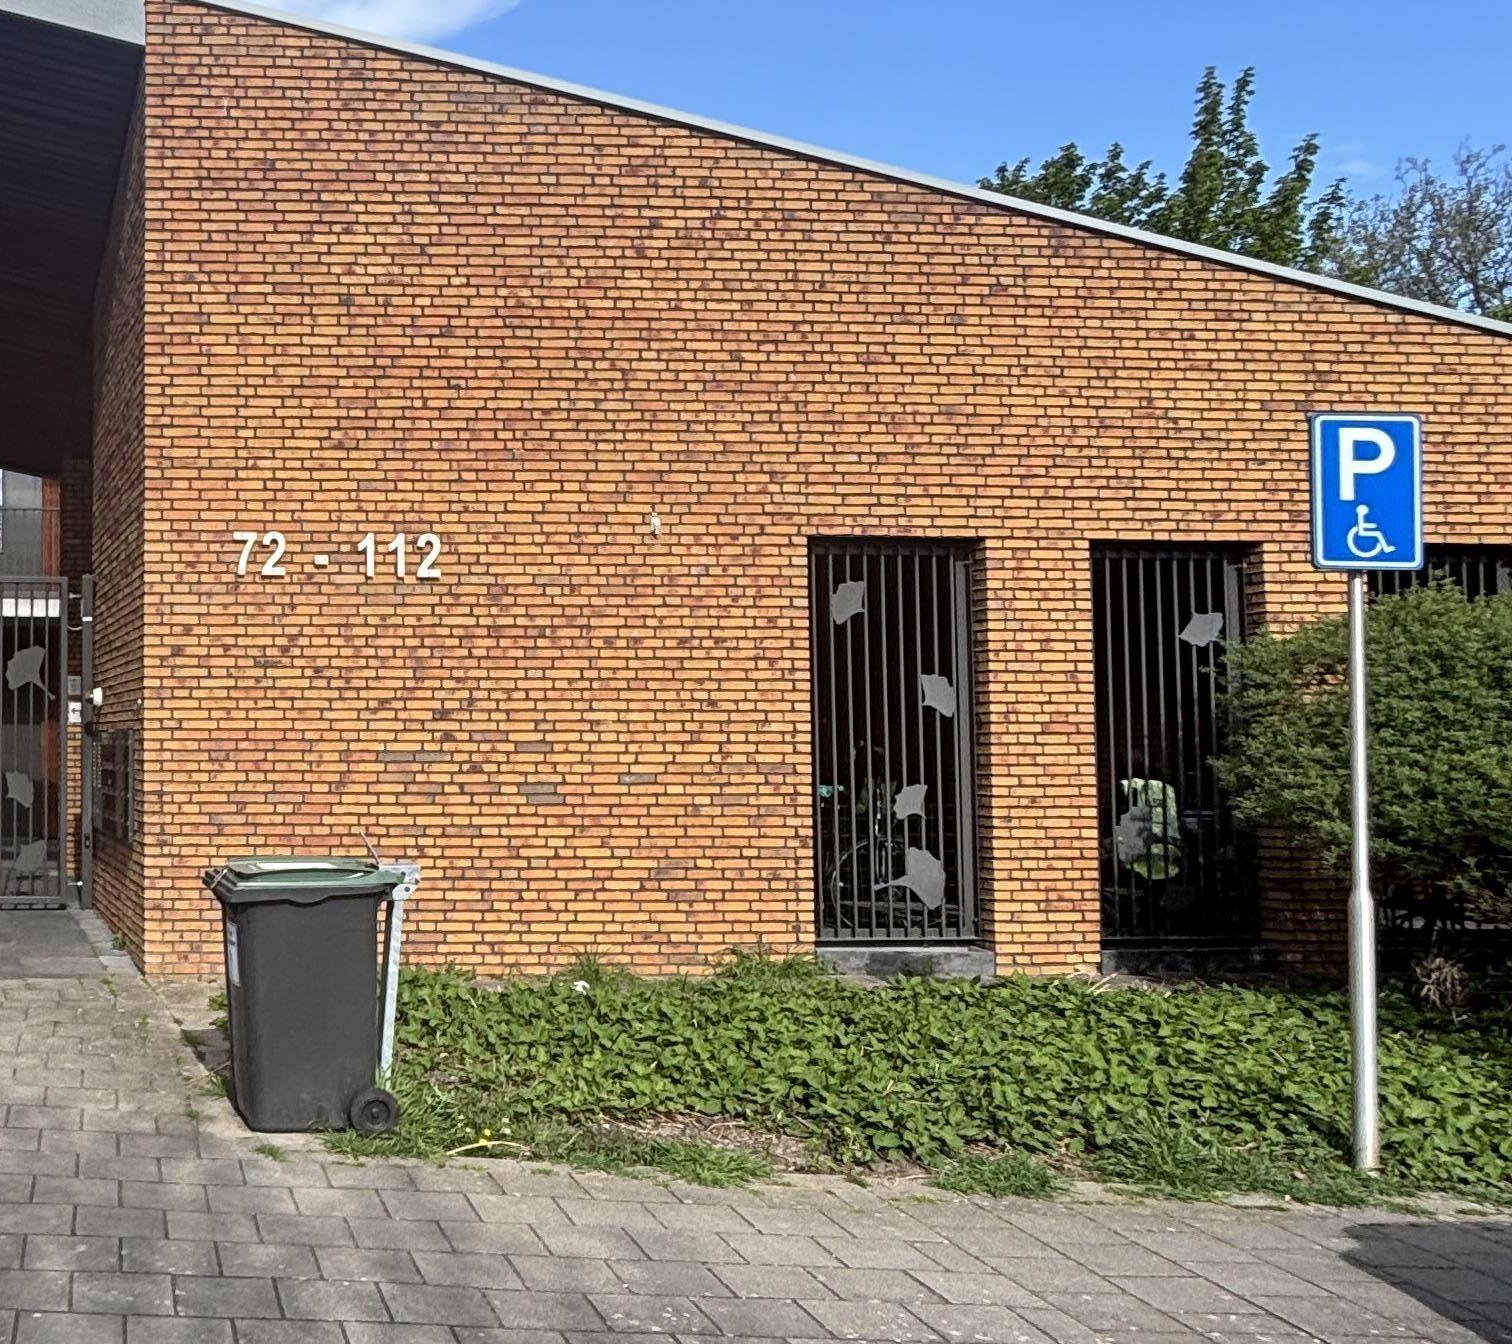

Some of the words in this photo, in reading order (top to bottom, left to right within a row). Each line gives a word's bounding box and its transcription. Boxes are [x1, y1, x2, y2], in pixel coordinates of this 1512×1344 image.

[1338, 427, 1396, 501] P
[233, 531, 286, 576] 72
[356, 532, 442, 578] 112
